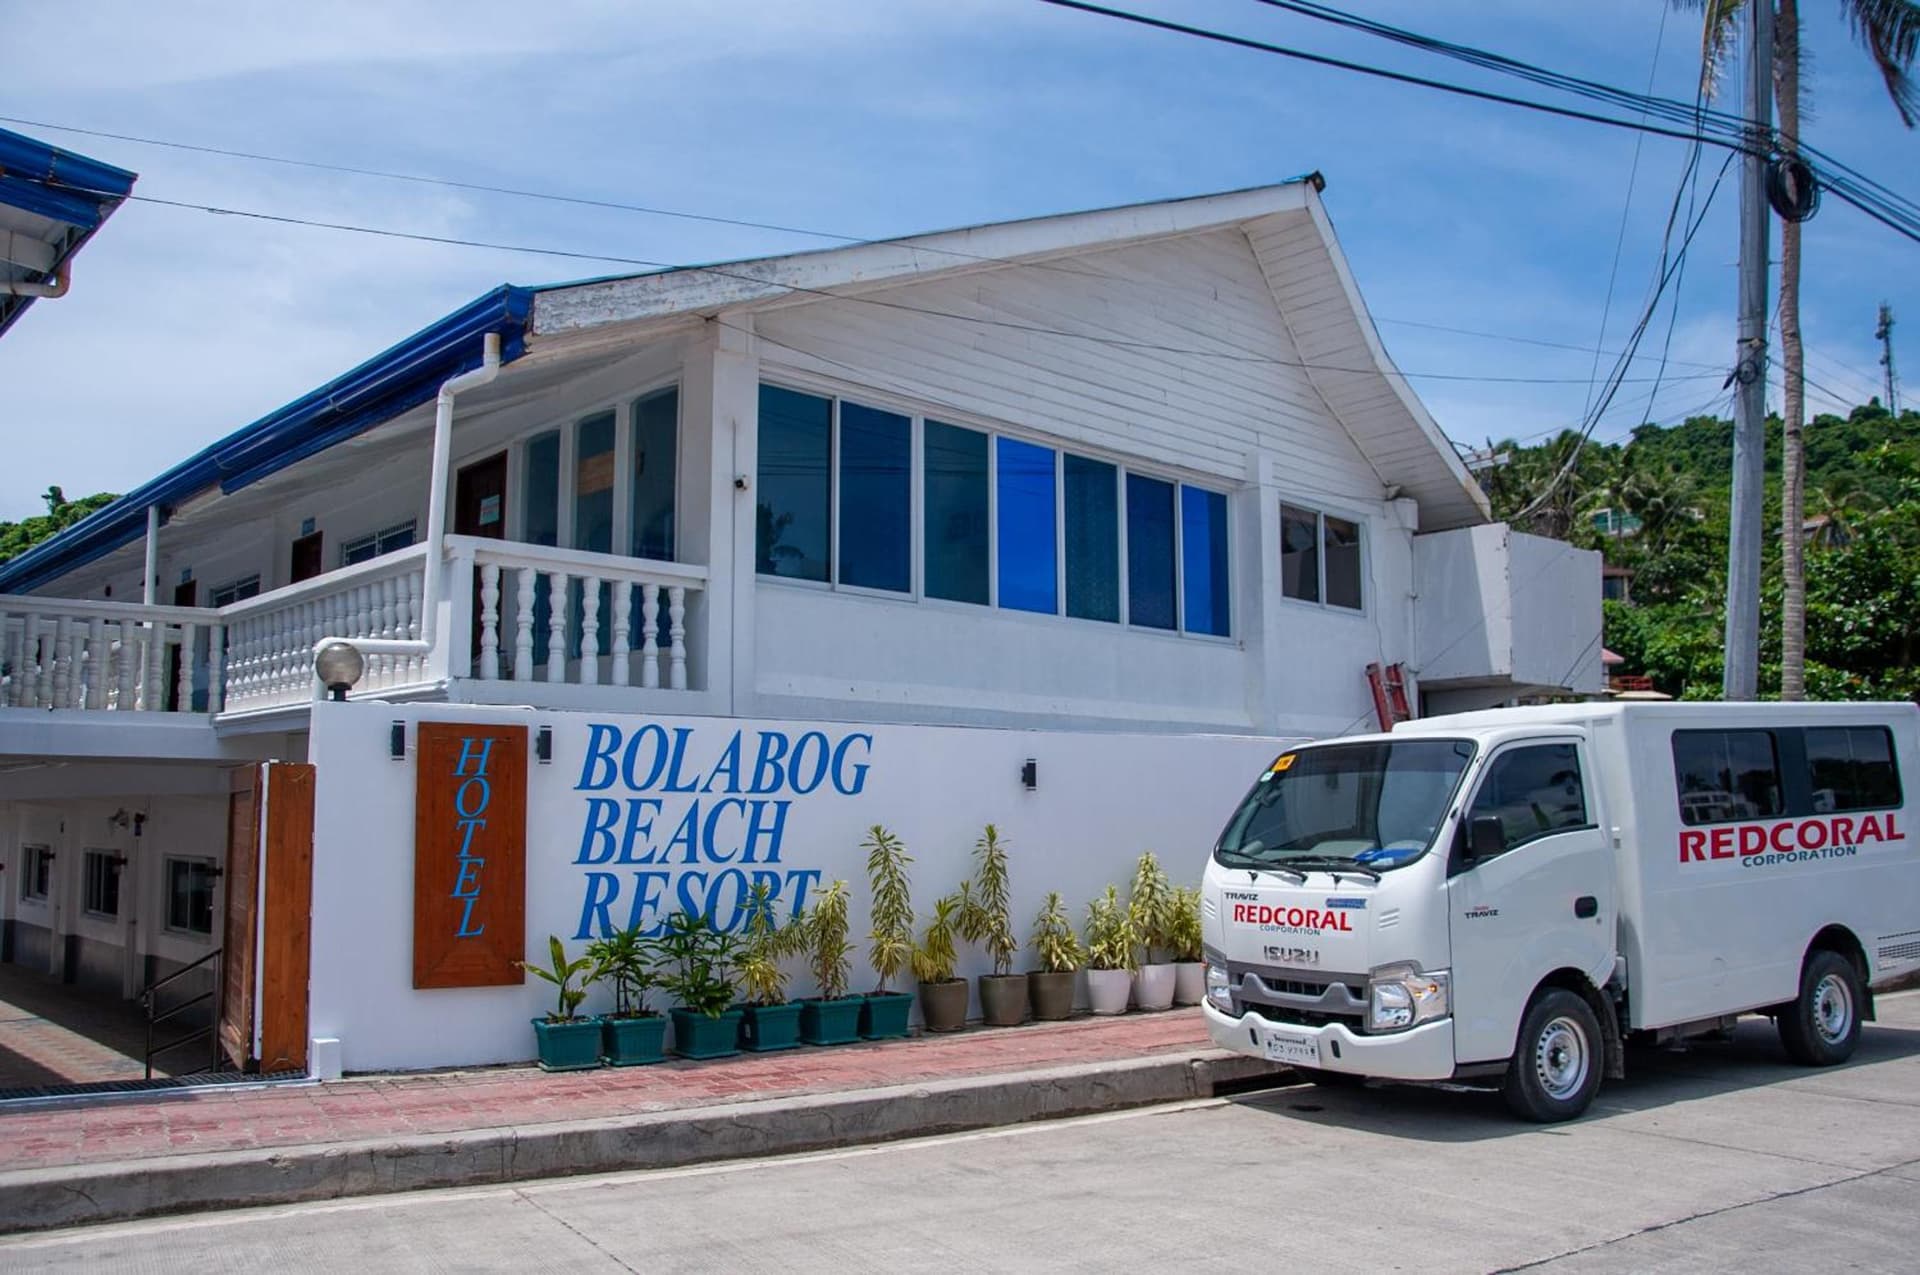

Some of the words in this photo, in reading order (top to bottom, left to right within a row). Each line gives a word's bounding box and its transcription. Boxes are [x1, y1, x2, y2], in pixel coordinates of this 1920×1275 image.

[573, 724, 873, 796] BOLABOG
[450, 738, 494, 937] HOTEL
[571, 798, 793, 865] BEACH
[1679, 814, 1905, 863] REDCORAL
[1742, 846, 1857, 868] CORPORATION
[570, 868, 822, 940] RESORT
[1224, 892, 1259, 901] TRAVIZ
[1234, 904, 1353, 932] REDCORAL
[1464, 909, 1499, 919] TRAVIZ
[1259, 924, 1320, 936] CORPORATION
[1263, 945, 1320, 964] ISUZU
